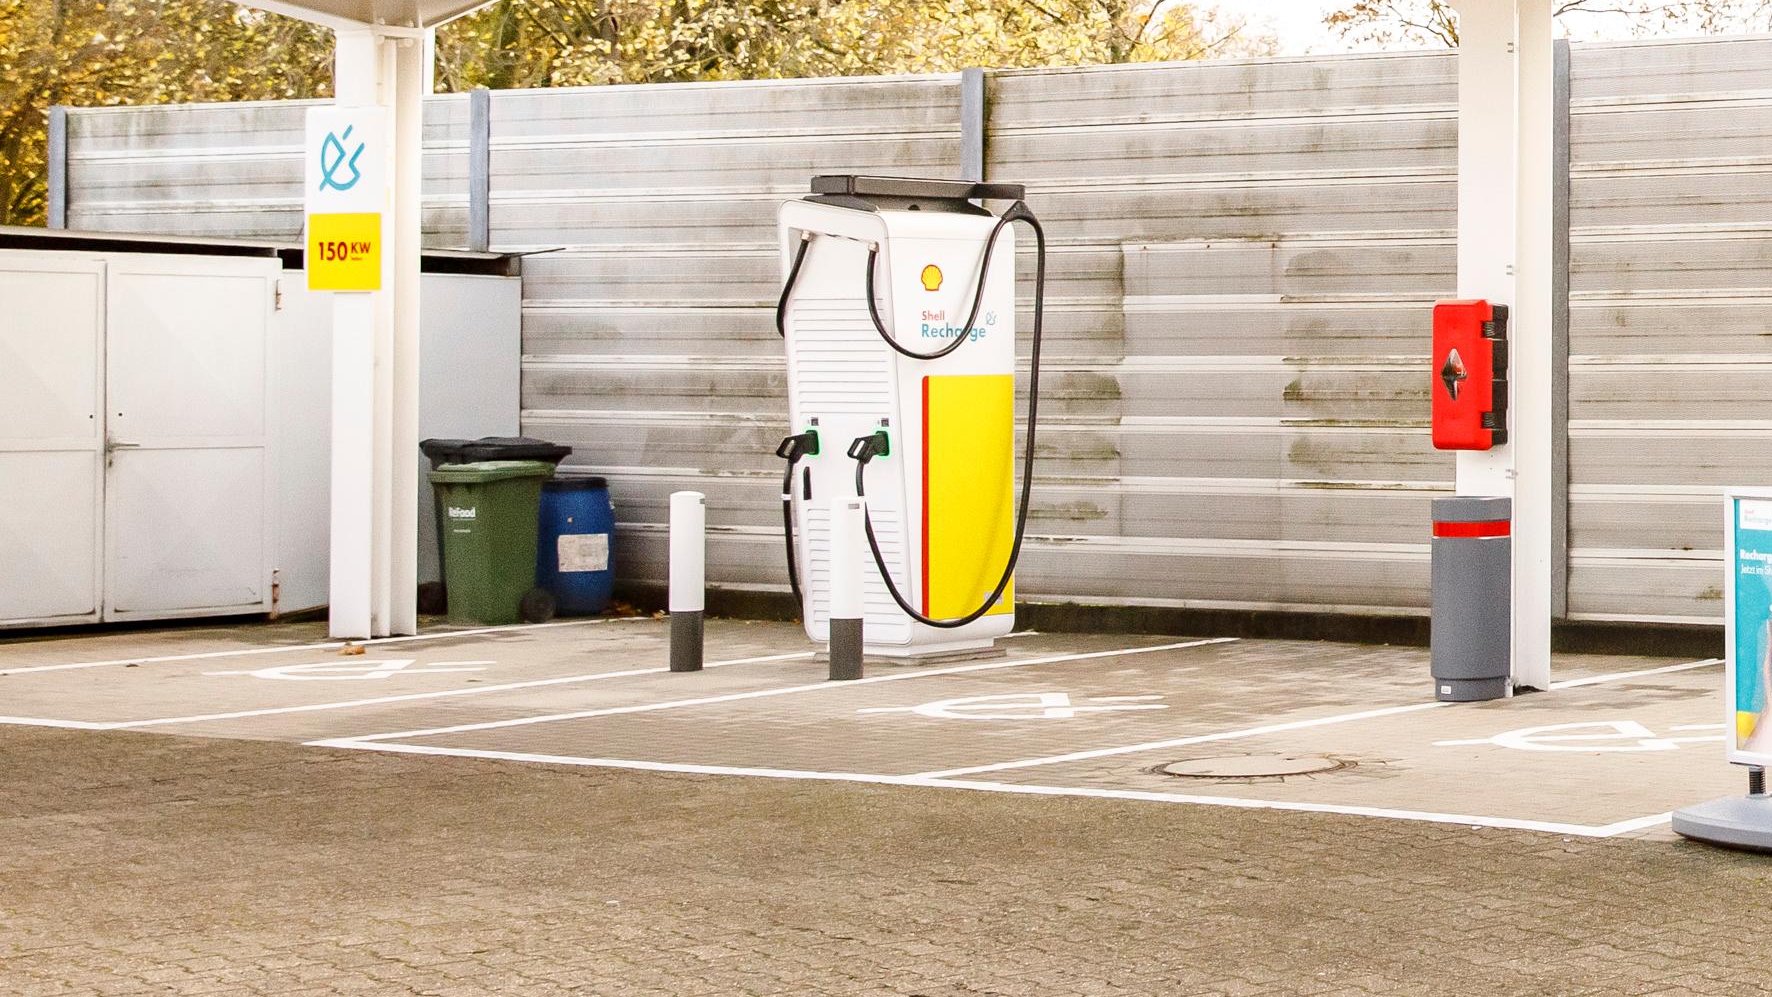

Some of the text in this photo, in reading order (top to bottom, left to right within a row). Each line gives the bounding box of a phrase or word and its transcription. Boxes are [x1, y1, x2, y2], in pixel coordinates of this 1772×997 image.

[318, 241, 371, 261] 150 KW
[921, 310, 945, 321] Shell
[921, 322, 987, 342] Rechage
